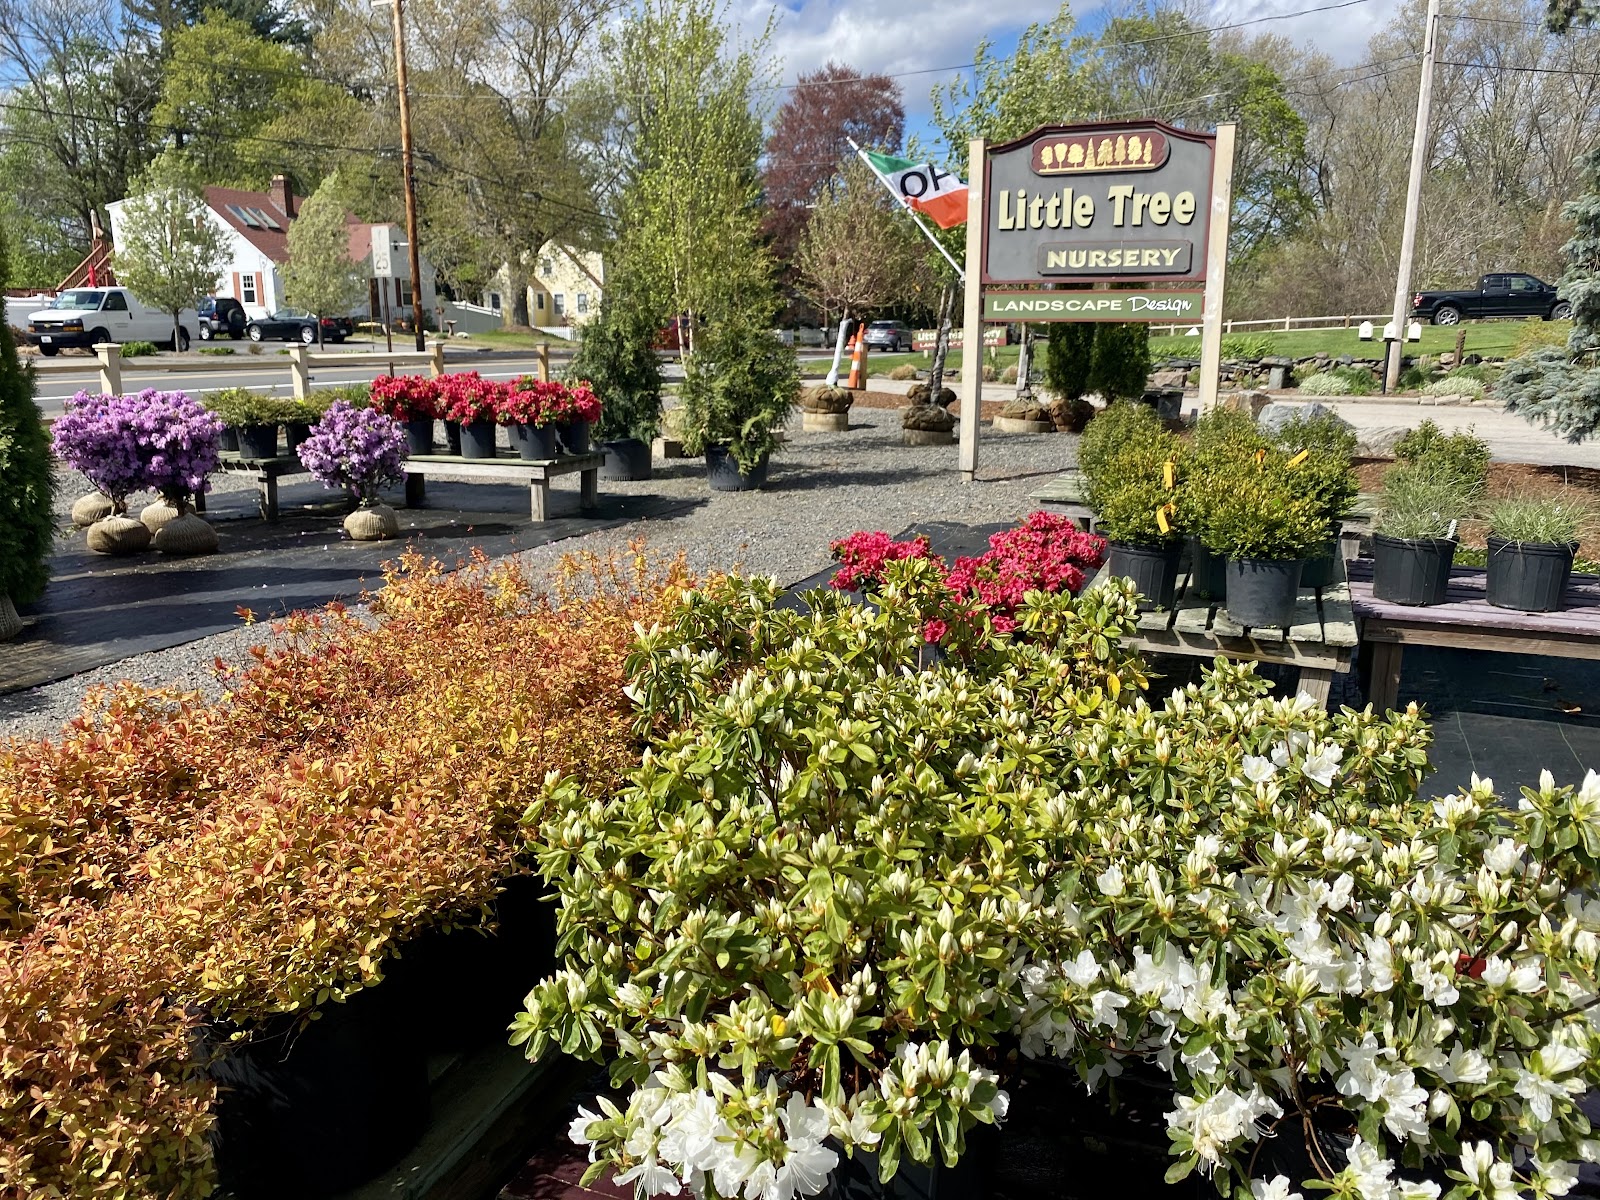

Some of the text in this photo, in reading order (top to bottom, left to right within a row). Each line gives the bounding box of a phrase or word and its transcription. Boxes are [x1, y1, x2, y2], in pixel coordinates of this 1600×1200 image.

[998, 185, 1196, 230] Little Tree
[375, 252, 389, 270] 25
[1047, 247, 1182, 269] NURSERY
[992, 296, 1192, 316] LANDSCAPE Design
